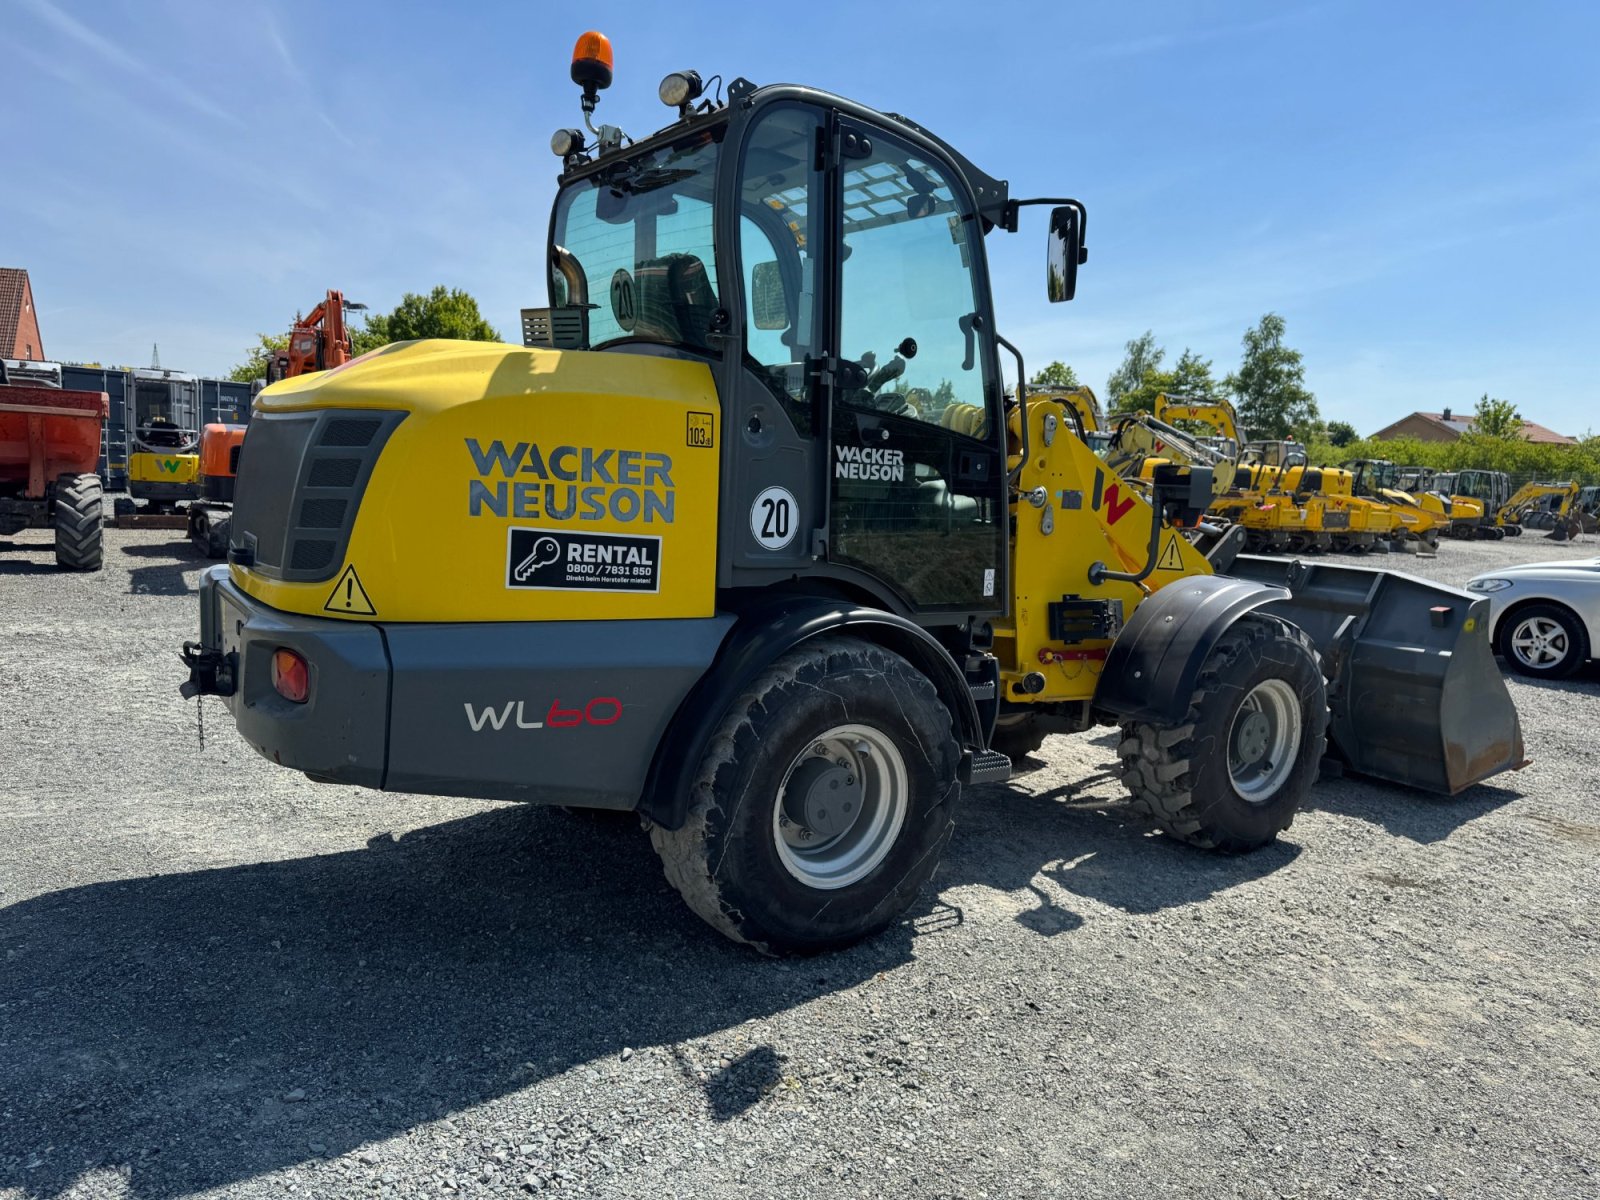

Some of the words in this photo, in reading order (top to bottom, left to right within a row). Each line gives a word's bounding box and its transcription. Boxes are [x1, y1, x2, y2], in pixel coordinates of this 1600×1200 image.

[615, 280, 634, 319] 20
[690, 427, 705, 445] 103
[464, 438, 676, 487] WACKER
[835, 445, 905, 466] WACKER
[835, 462, 905, 482] NEUSON
[469, 480, 676, 523] NEUSON
[761, 498, 790, 538] 20
[567, 542, 653, 566] RENTAL
[566, 563, 595, 574] 0800
[605, 565, 630, 575] 7831
[632, 566, 652, 576] 850
[566, 574, 586, 582] Direkt
[463, 697, 624, 732] WL60
